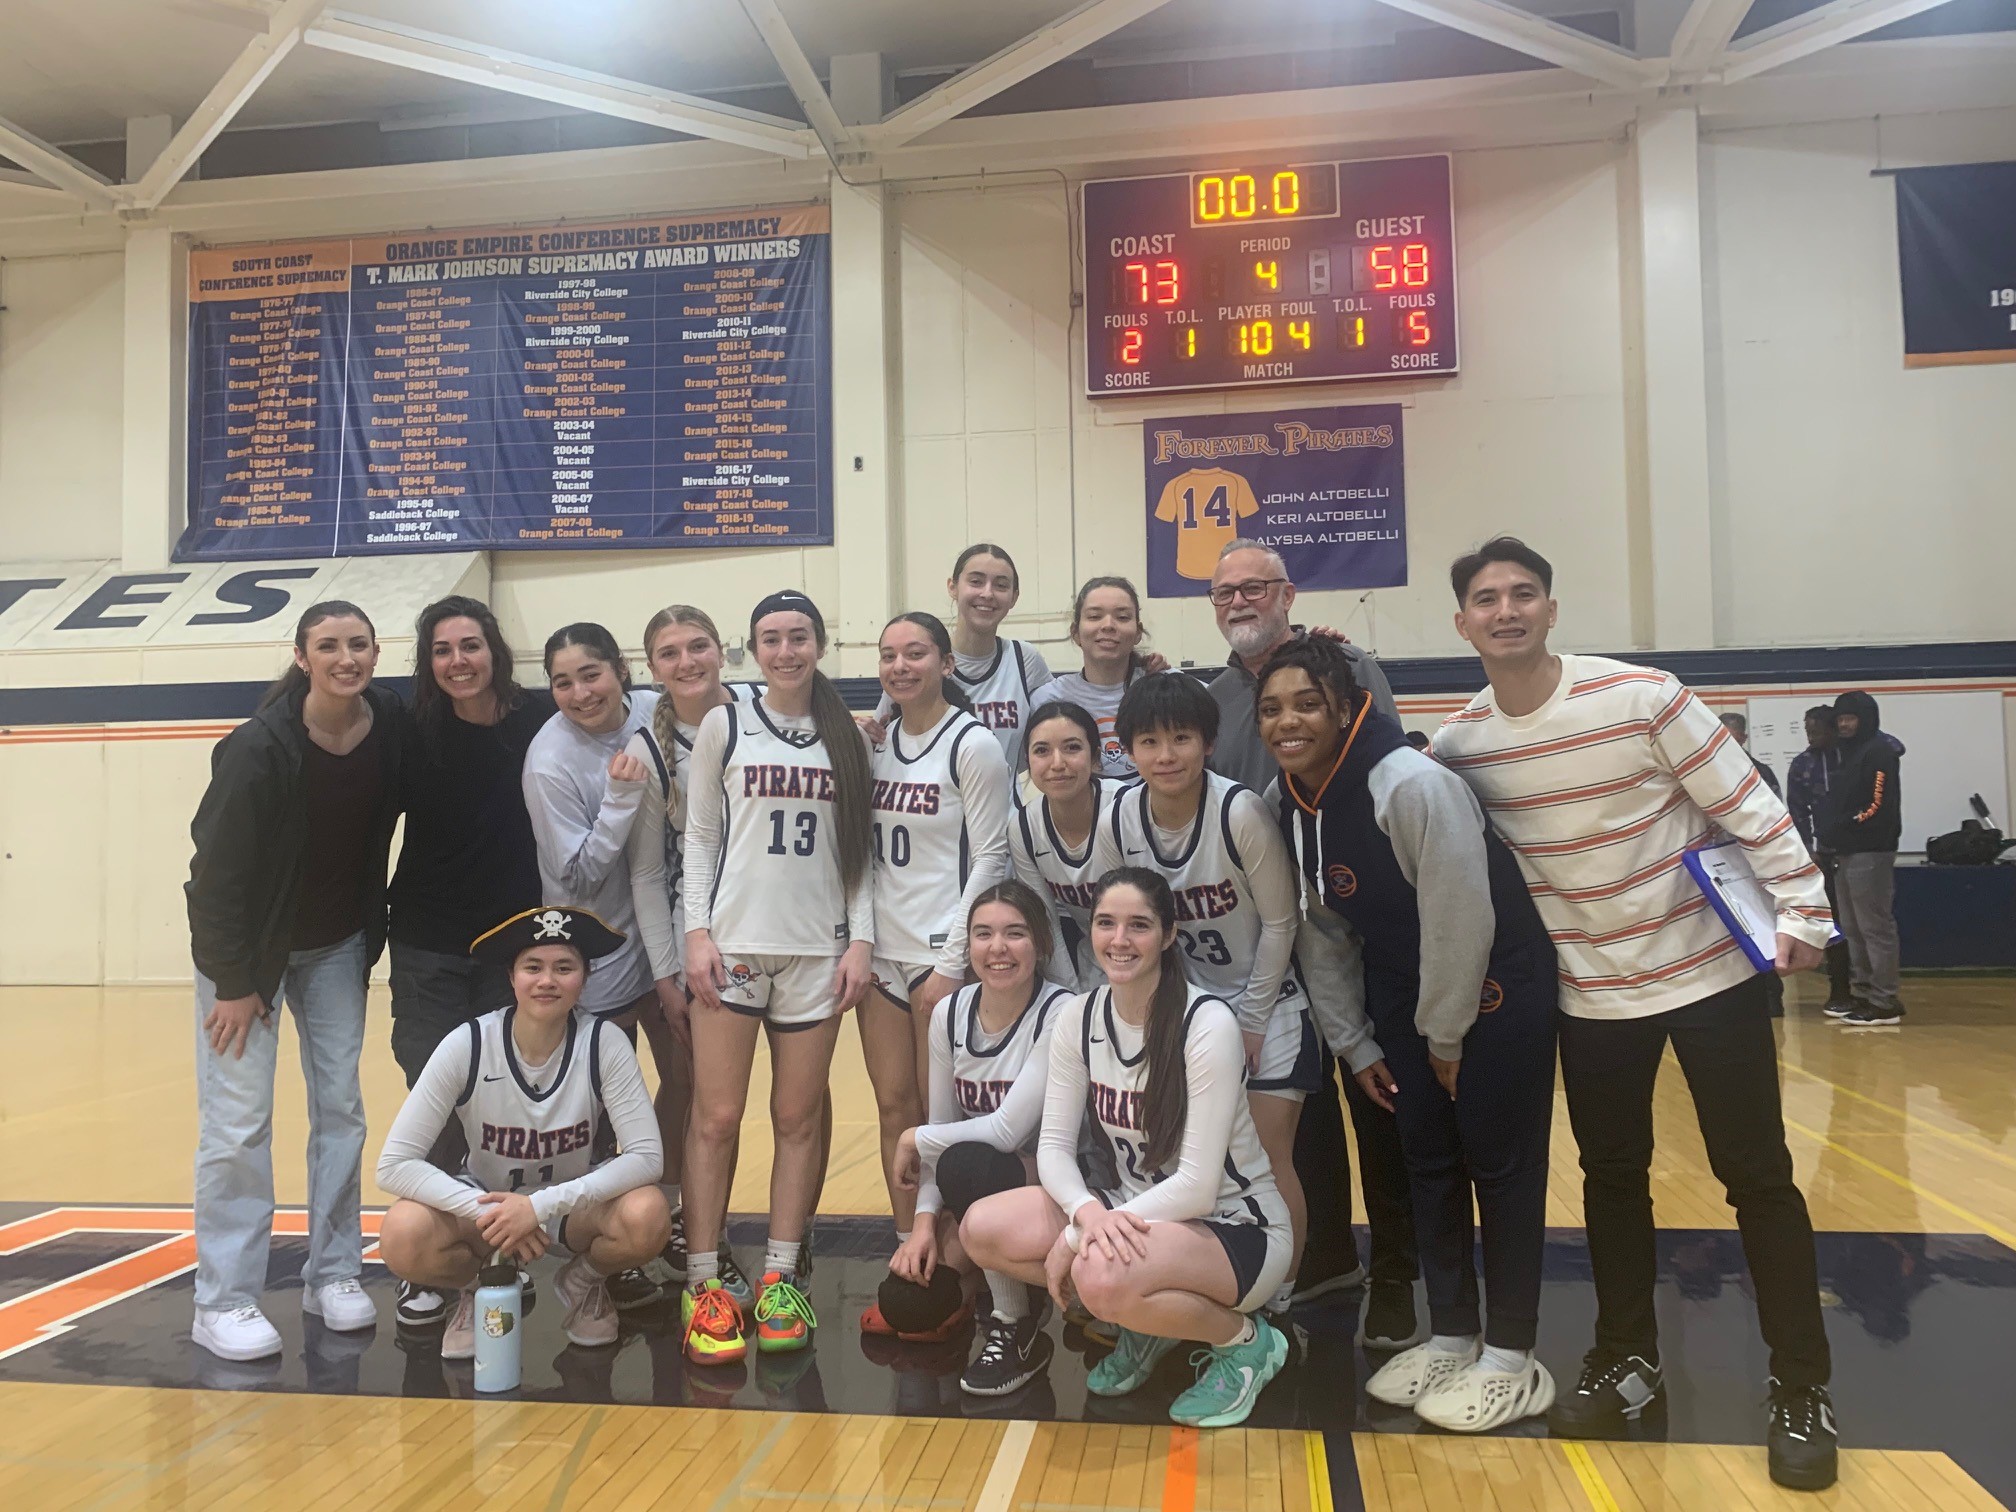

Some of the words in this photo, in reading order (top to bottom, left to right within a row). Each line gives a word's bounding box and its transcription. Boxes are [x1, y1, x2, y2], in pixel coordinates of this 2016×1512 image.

[1200, 171, 1299, 220] 00.0
[1356, 216, 1425, 239] GUEST
[386, 240, 457, 261] ORANGE
[463, 235, 532, 255] EMPIRE
[539, 226, 660, 250] CONFERENCE
[666, 217, 781, 245] SUPREMACY
[1111, 234, 1175, 257] COAST
[1240, 237, 1291, 253] PERIOD
[233, 259, 271, 272] SOUTH
[275, 254, 312, 268] COAST
[367, 267, 382, 284] T.
[388, 263, 439, 283] MARK
[443, 258, 521, 279] JOHNSON
[528, 251, 639, 274] SUPREMACY
[644, 247, 708, 269] AWARD
[714, 239, 800, 262] WINNERS
[1371, 244, 1429, 288] 58
[199, 275, 273, 291] CONFERENCE
[277, 270, 346, 285] SUPREMACY
[1126, 261, 1179, 304] 73
[1256, 260, 1277, 290] 4
[558, 279, 595, 288] 1997-98
[683, 281, 716, 293] Orange
[719, 280, 746, 289] Coast
[749, 278, 784, 289] College
[524, 290, 569, 300] Riverside
[572, 290, 590, 300] City
[593, 288, 627, 299] College
[1390, 293, 1436, 309] FOULS
[1990, 288, 2016, 307] 19
[376, 300, 408, 311] Orange
[410, 298, 435, 308] Coast
[438, 296, 470, 308] College
[683, 305, 717, 317] Orange
[720, 304, 746, 313] Coast
[749, 302, 784, 313] College
[1219, 304, 1272, 321] PLAYER
[1281, 301, 1317, 316] FOUL
[1333, 298, 1372, 313] T.O.L.
[525, 314, 559, 324] Orange
[561, 313, 587, 322] Coast
[590, 311, 625, 322] College
[716, 317, 750, 326] 2010-11
[1105, 313, 1148, 328] FOULS
[1165, 310, 1203, 324] T.O.L.
[550, 326, 600, 335] 1999-2000
[682, 329, 726, 339] Riverside
[729, 328, 748, 338] City
[751, 326, 786, 337] College
[1410, 311, 1430, 344] 5
[525, 337, 569, 346] Riverside
[572, 336, 591, 346] City
[593, 335, 629, 346] College
[1241, 321, 1273, 355] 10
[1290, 321, 1310, 350] 4
[716, 341, 750, 350] 2011-12
[1123, 330, 1142, 363] 2
[683, 353, 717, 364] Orange
[719, 352, 746, 361] Coast
[749, 350, 784, 361] College
[1391, 353, 1439, 368] SCORE
[524, 361, 558, 372] Orange
[560, 360, 587, 369] Coast
[590, 360, 625, 370] College
[715, 365, 751, 374] 2012-13
[1244, 362, 1293, 378] MATCH
[555, 373, 593, 382] 2001-02
[684, 378, 718, 389] Orange
[721, 376, 747, 385] Coast
[750, 375, 786, 386] College
[1105, 372, 1150, 387] SCORE
[524, 385, 558, 395] Orange
[560, 384, 586, 393] Coast
[589, 383, 625, 394] College
[715, 389, 751, 398] 2013-14
[523, 408, 557, 419] Orange
[560, 408, 586, 416] Coast
[589, 407, 625, 418] College
[684, 402, 718, 412] Orange
[721, 401, 747, 410] Coast
[750, 399, 786, 410] College
[553, 421, 594, 430] 2003-04
[684, 426, 718, 437] Orange
[720, 425, 748, 434] Coast
[751, 424, 787, 435] College
[557, 432, 590, 440] Vacant
[553, 446, 594, 454] 2004-05
[684, 452, 718, 462] Orange
[720, 451, 748, 459] Coast
[751, 450, 787, 460] College
[556, 456, 590, 465] Vacant
[552, 470, 593, 480] 2005-06
[715, 465, 752, 474] 2016-17
[556, 481, 589, 490] Vacant
[682, 476, 728, 485] Riverside
[731, 476, 750, 486] City
[752, 475, 789, 486] College
[366, 488, 399, 498] Orange
[402, 487, 428, 496] Coast
[430, 486, 465, 496] College
[551, 494, 592, 503] 2006-07
[1263, 493, 1304, 504] JOHN
[1309, 488, 1389, 501] ALTOBELLI
[555, 505, 588, 514] Vacant
[683, 502, 718, 512] Orange
[721, 501, 748, 510] Coast
[751, 500, 788, 510] College
[1182, 486, 1231, 529] 14
[368, 510, 422, 519] Saddleback
[425, 509, 459, 519] College
[1267, 514, 1301, 525] KERI
[1306, 509, 1386, 523] ALTOBELLI
[366, 533, 420, 543] Saddleback
[423, 532, 457, 542] College
[519, 529, 553, 539] Orange
[556, 529, 583, 537] Coast
[586, 528, 622, 538] College
[684, 526, 719, 536] Orange
[721, 526, 749, 534] Coast
[752, 525, 788, 535] College
[1256, 532, 1314, 545] ALYSSA
[1318, 530, 1398, 543] ALTOBELLI
[744, 765, 838, 802] PIRATE
[871, 778, 940, 816] RATES
[767, 809, 817, 856] 13
[1173, 878, 1238, 921] ATES
[1176, 928, 1232, 966] 23
[481, 1119, 590, 1160] PIRATES
[508, 1164, 555, 1192] 11
